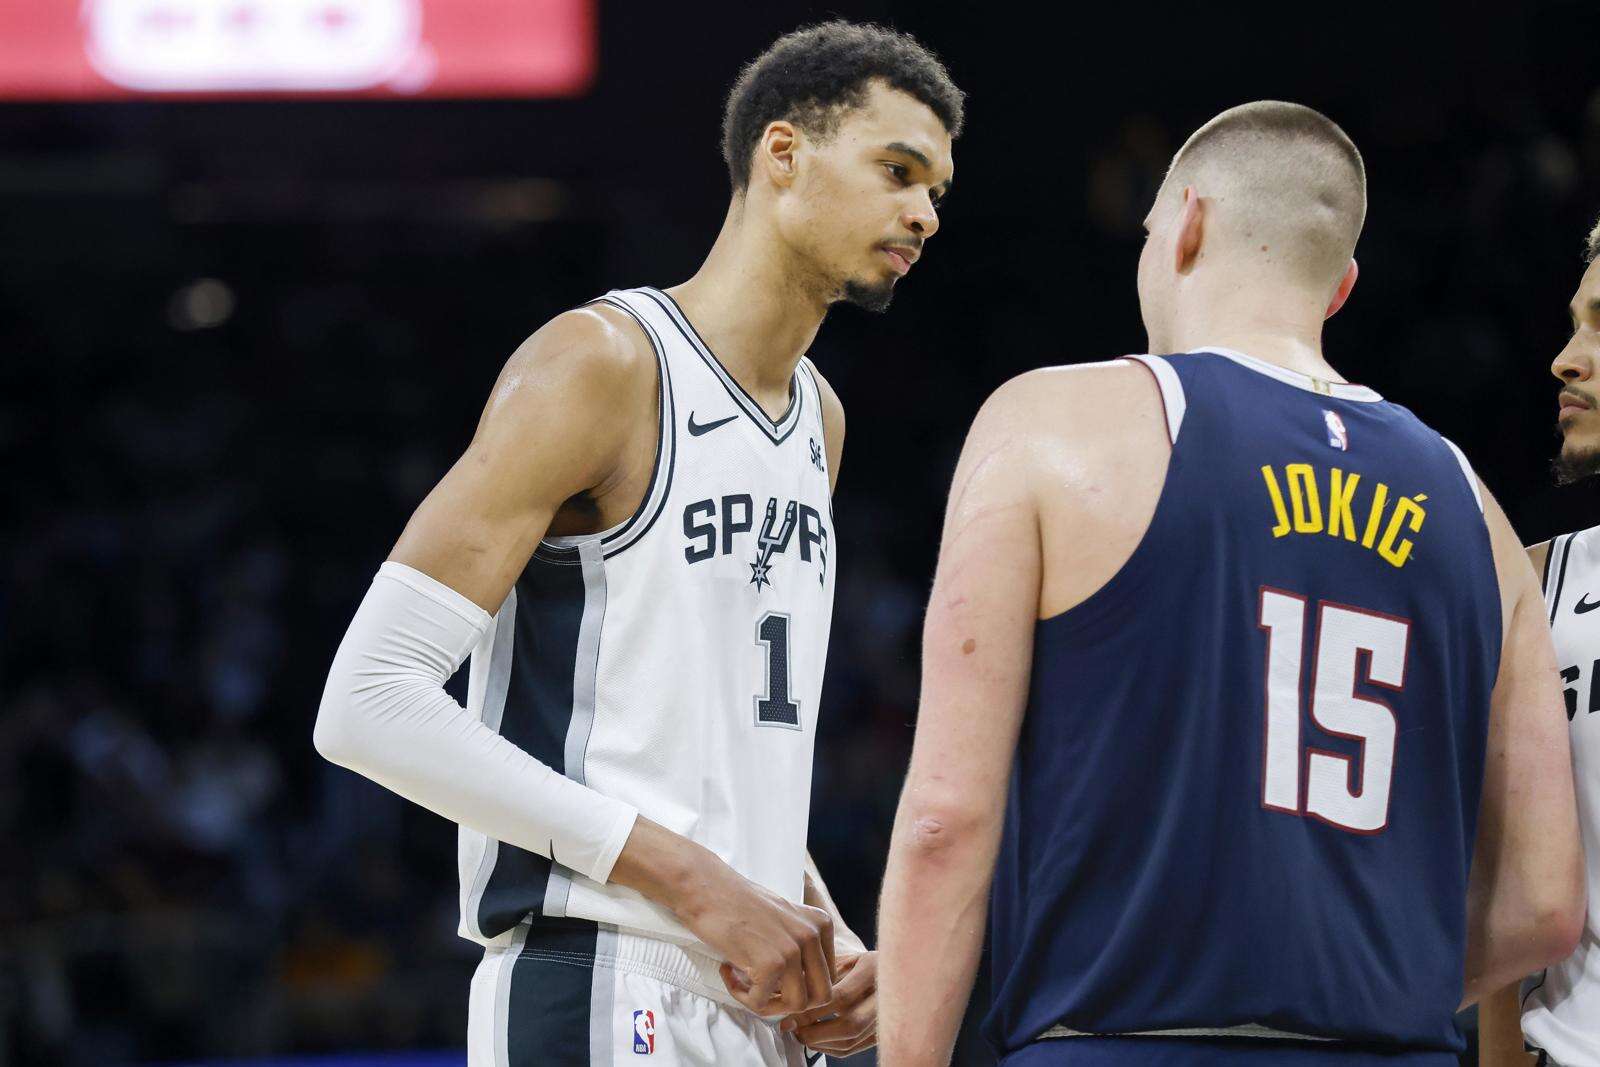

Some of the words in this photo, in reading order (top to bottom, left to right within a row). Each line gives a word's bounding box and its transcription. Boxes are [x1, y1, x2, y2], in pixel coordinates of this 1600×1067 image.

[1261, 463, 1428, 568] JOKIĆ
[753, 610, 802, 732] 1
[1258, 585, 1411, 836] 15
